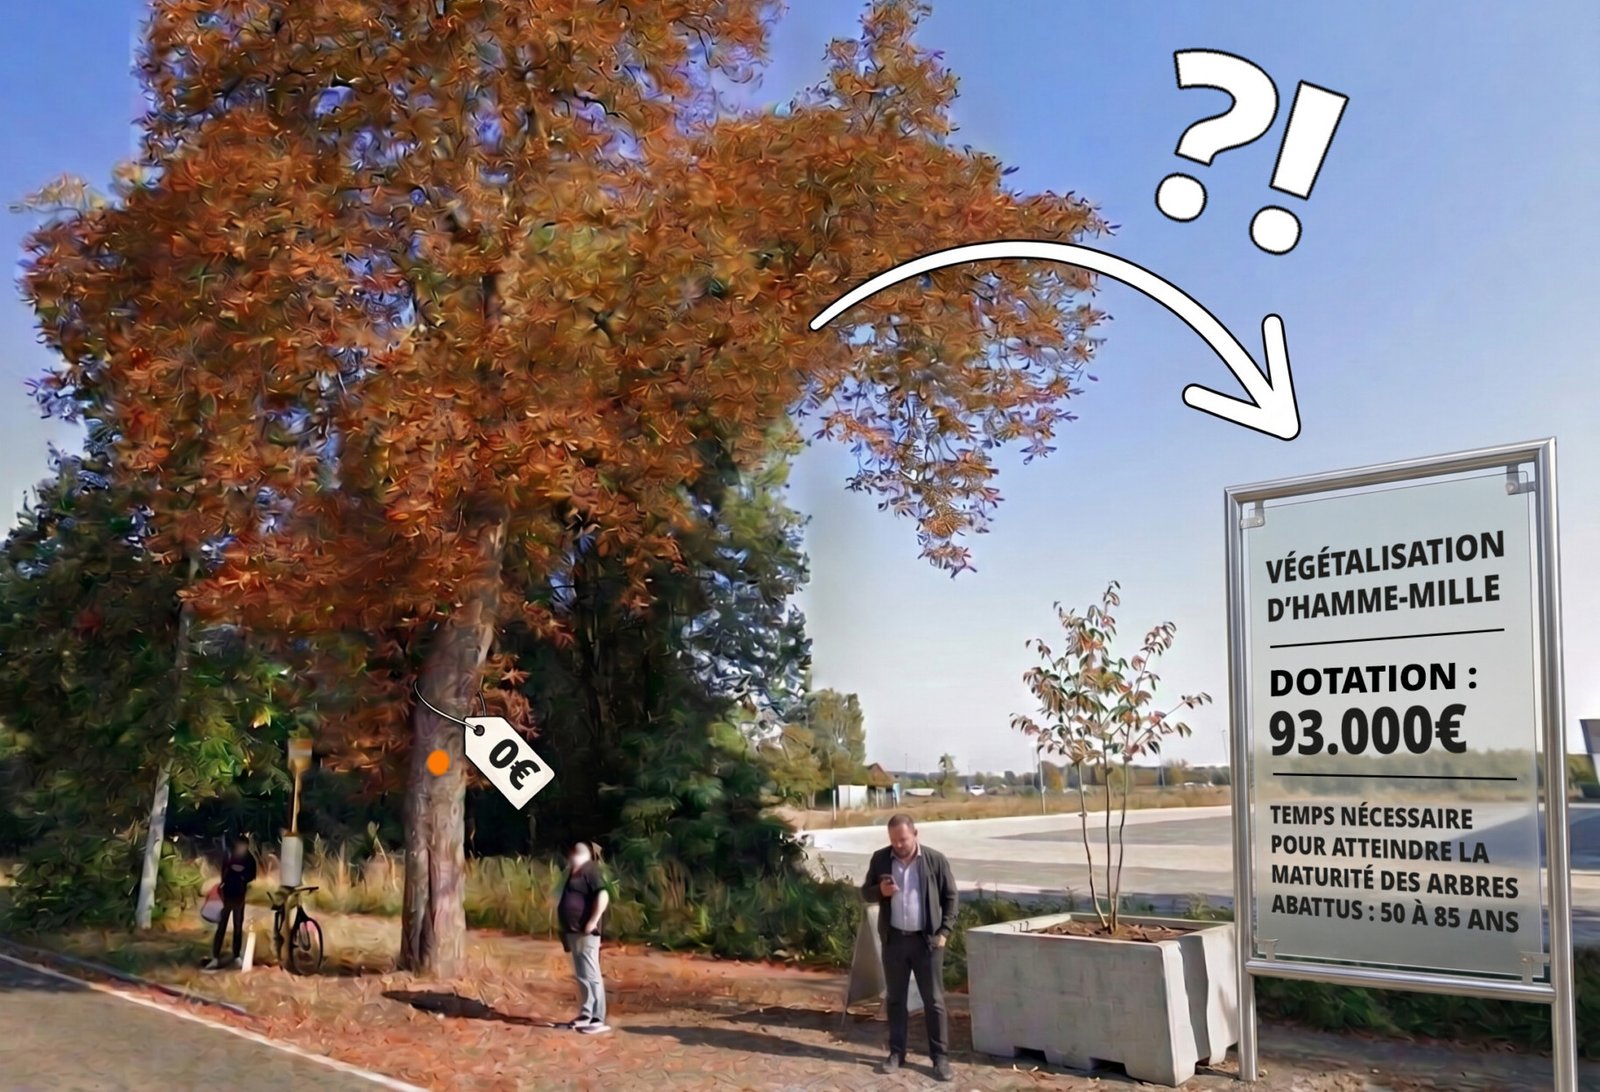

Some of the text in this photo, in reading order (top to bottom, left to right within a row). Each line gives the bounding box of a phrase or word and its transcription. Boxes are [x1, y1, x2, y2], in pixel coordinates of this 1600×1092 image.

[1266, 531, 1504, 583] VÉGÉTALISATION
[1268, 575, 1499, 622] D’HAMME-MILLE
[1270, 663, 1456, 696] DOTATION
[1270, 704, 1467, 756] 93.000€
[489, 739, 541, 790] 0€
[1270, 802, 1472, 829] TEMPS NÉCESSAIRE
[1272, 835, 1489, 863] POUR ATTEINDRE LA
[1272, 865, 1518, 898] MATURITÉ DES ARBRES
[1272, 895, 1362, 920] ABATTUS
[1381, 902, 1405, 923] 50
[1412, 899, 1428, 925] À
[1435, 907, 1460, 927] 85
[1468, 909, 1519, 933] ANS
